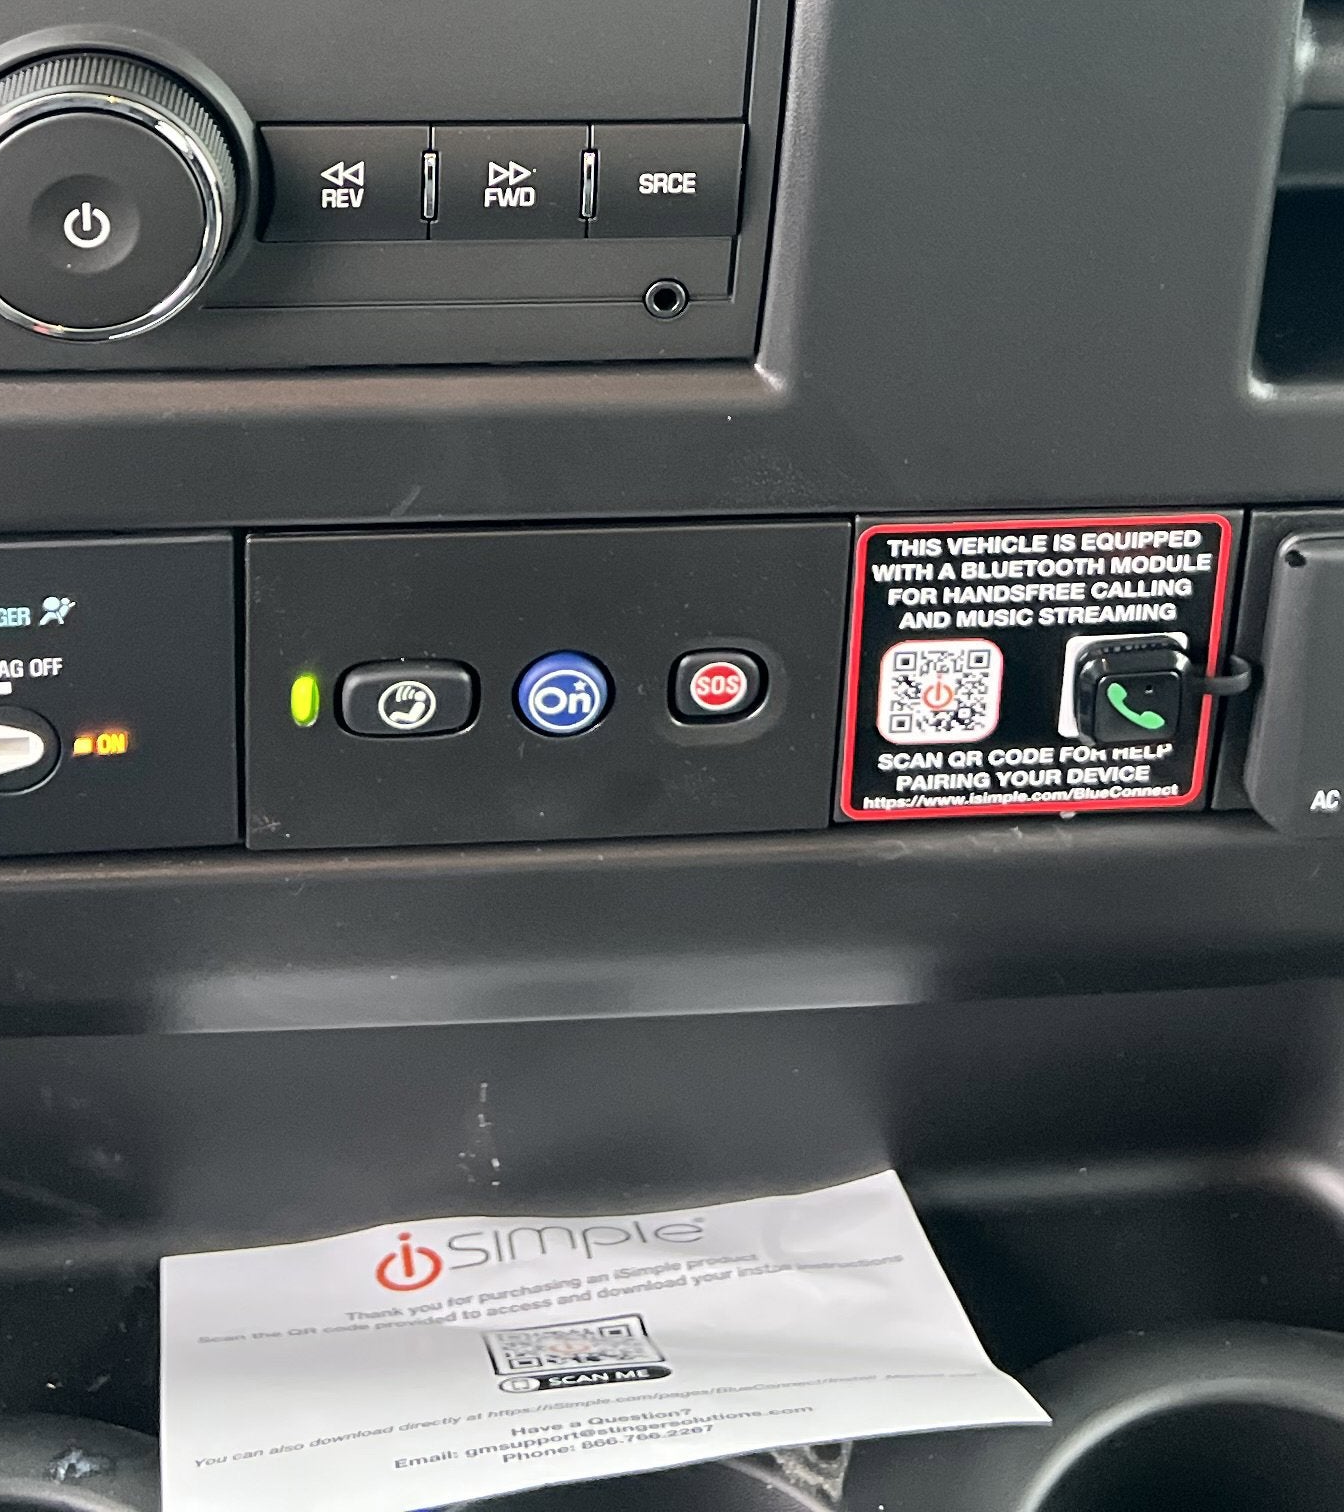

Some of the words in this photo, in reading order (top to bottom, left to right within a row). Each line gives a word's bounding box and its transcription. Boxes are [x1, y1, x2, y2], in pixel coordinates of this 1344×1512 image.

[639, 173, 697, 194] SRCE
[321, 188, 364, 208] REV
[484, 187, 535, 207] FWD
[887, 538, 942, 557] THIS
[948, 535, 1050, 555] VEHICLE
[1053, 533, 1076, 552] IS
[1081, 530, 1202, 551] EQUIPPED
[871, 563, 933, 582] WITH
[938, 563, 955, 581] A
[961, 558, 1106, 580] BLUETOOTH
[1109, 553, 1213, 576] MODULE
[888, 588, 938, 606] FOR
[943, 583, 1086, 605] HANDSFREE
[1090, 578, 1193, 600] CALLING
[898, 611, 952, 630] AND
[955, 608, 1034, 628] MUSIC
[1037, 603, 1177, 625] STREAMING
[29, 658, 63, 678] OFF
[697, 675, 740, 696] SOS
[97, 733, 127, 756] ON
[877, 751, 943, 772] SCAN
[948, 749, 983, 769] QR
[987, 746, 1055, 767] CODE
[896, 772, 991, 792] PAIRING
[994, 769, 1062, 788] YOUR
[1066, 764, 1150, 785] DEVICE
[1309, 790, 1340, 812] AC
[345, 1306, 404, 1321] Thank
[408, 1301, 443, 1317] you
[447, 1294, 474, 1307] for
[478, 1276, 581, 1305] purchasing
[587, 1272, 610, 1285] an
[686, 1253, 758, 1272] product
[197, 1334, 246, 1345] Scan
[252, 1330, 282, 1340] the
[287, 1326, 316, 1337] QR
[323, 1322, 369, 1335] code
[374, 1311, 457, 1332] provided
[463, 1308, 481, 1321] to
[487, 1297, 552, 1316] access
[557, 1289, 592, 1306] and
[597, 1274, 687, 1300] download
[692, 1269, 732, 1287] your
[548, 1372, 610, 1387] SCAN
[615, 1368, 650, 1381] ME
[511, 1422, 563, 1437] Have
[569, 1419, 582, 1428] a
[587, 1407, 692, 1427] Question?
[195, 1455, 228, 1469] You
[232, 1448, 264, 1462] can
[269, 1442, 305, 1456] also
[309, 1425, 394, 1448] download
[398, 1414, 462, 1433] directly
[466, 1412, 483, 1422] at
[394, 1449, 460, 1469] Email:
[502, 1444, 576, 1464] Phone:
